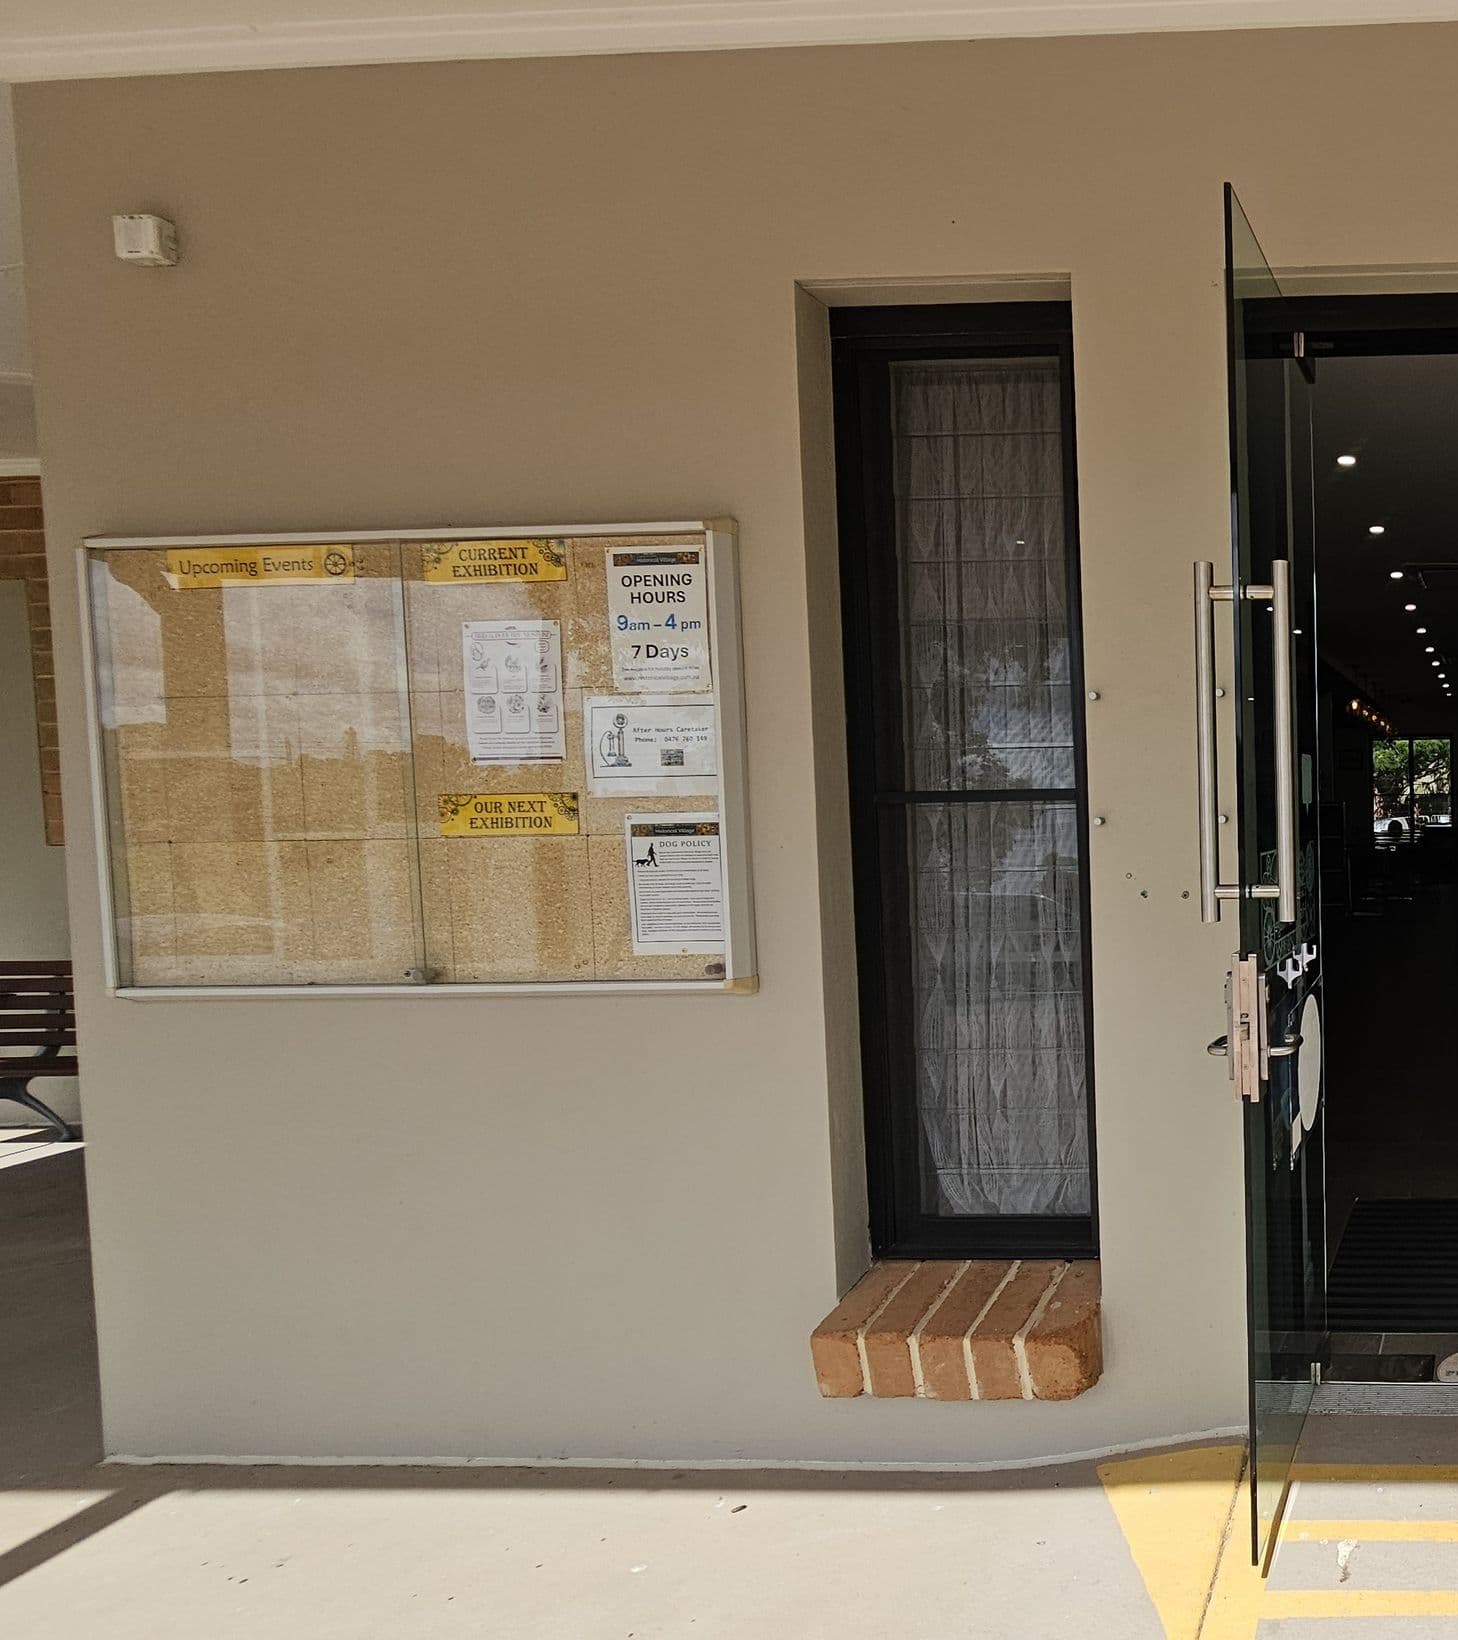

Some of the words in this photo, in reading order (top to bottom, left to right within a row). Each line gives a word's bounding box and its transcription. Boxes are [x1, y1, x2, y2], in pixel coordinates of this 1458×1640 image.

[458, 546, 528, 561] CURRENT
[178, 559, 259, 577] Upcoming
[262, 557, 314, 572] Events
[452, 562, 539, 578] EXHIBITION
[621, 573, 693, 588] OPENING
[630, 590, 686, 604] HOURS
[617, 614, 650, 631] 9am
[665, 613, 677, 630] 4
[681, 620, 701, 632] pm
[631, 644, 641, 659] 7
[646, 644, 689, 661] Days
[474, 801, 503, 814] OUR
[508, 800, 547, 813] NEXT
[469, 816, 553, 830] EXHIBITION
[681, 840, 712, 848] POLICY
